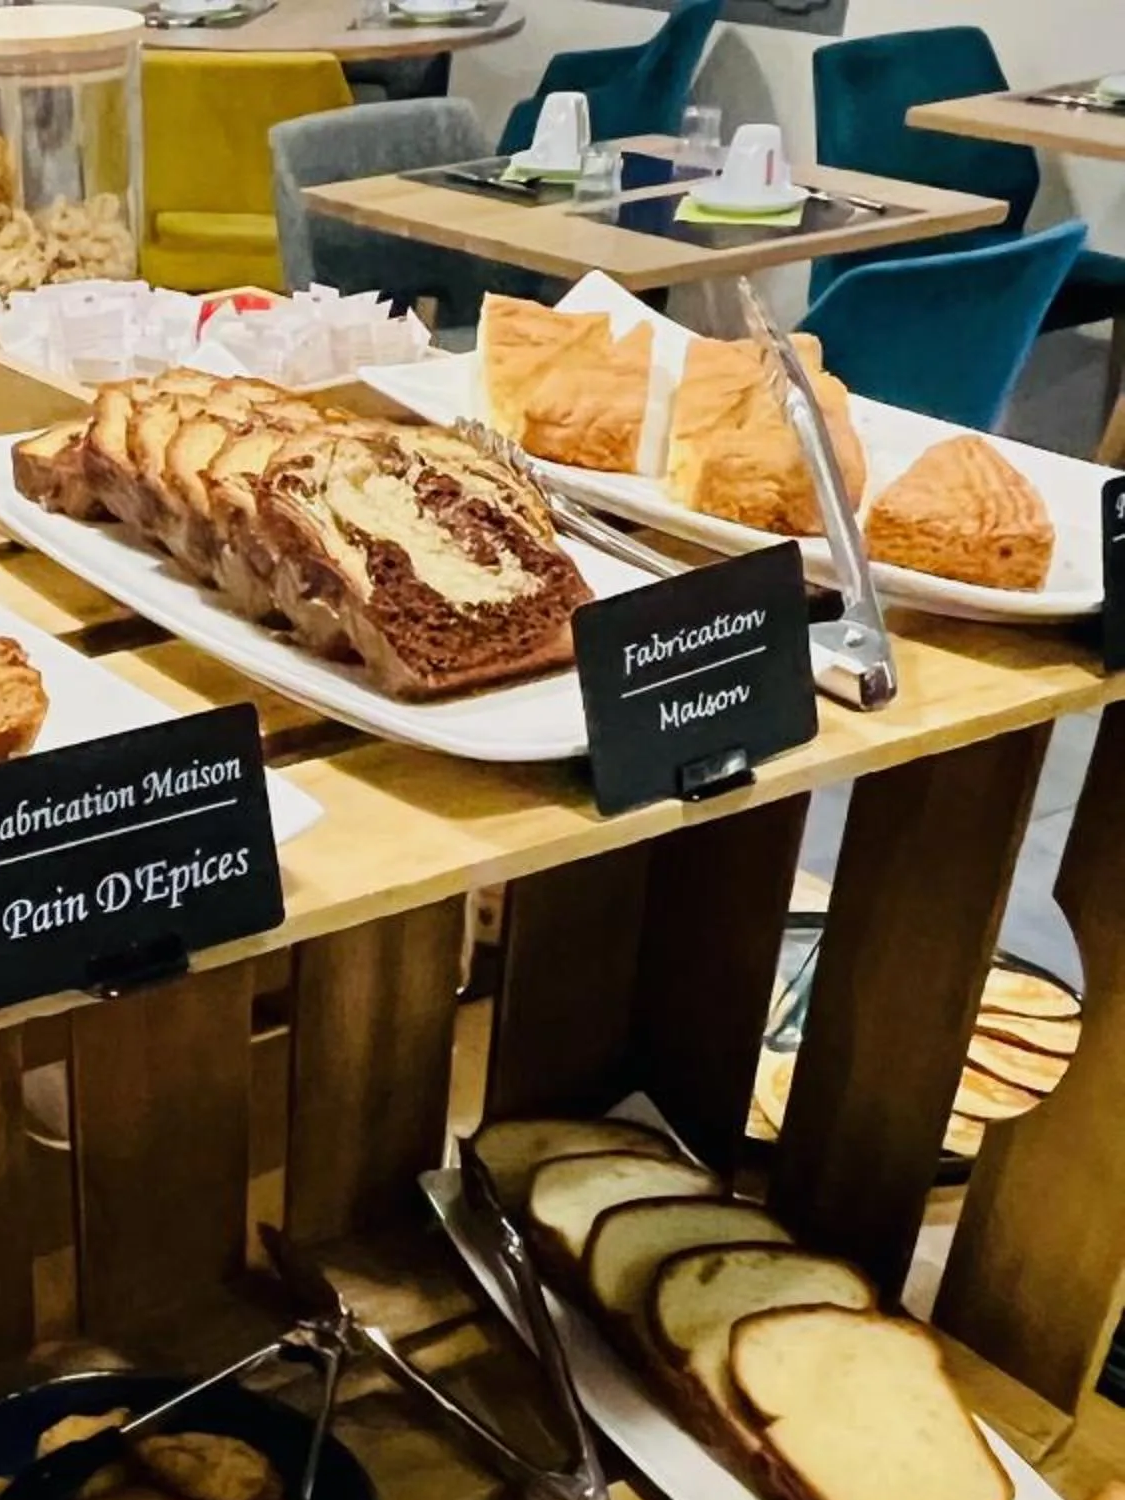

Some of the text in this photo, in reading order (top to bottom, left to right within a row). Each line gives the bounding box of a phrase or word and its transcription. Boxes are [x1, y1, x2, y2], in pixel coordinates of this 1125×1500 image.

[621, 608, 767, 676] Fabrication
[659, 685, 751, 731] Maison
[142, 757, 242, 804] Maison
[2, 847, 250, 940] Pain D'Epices
